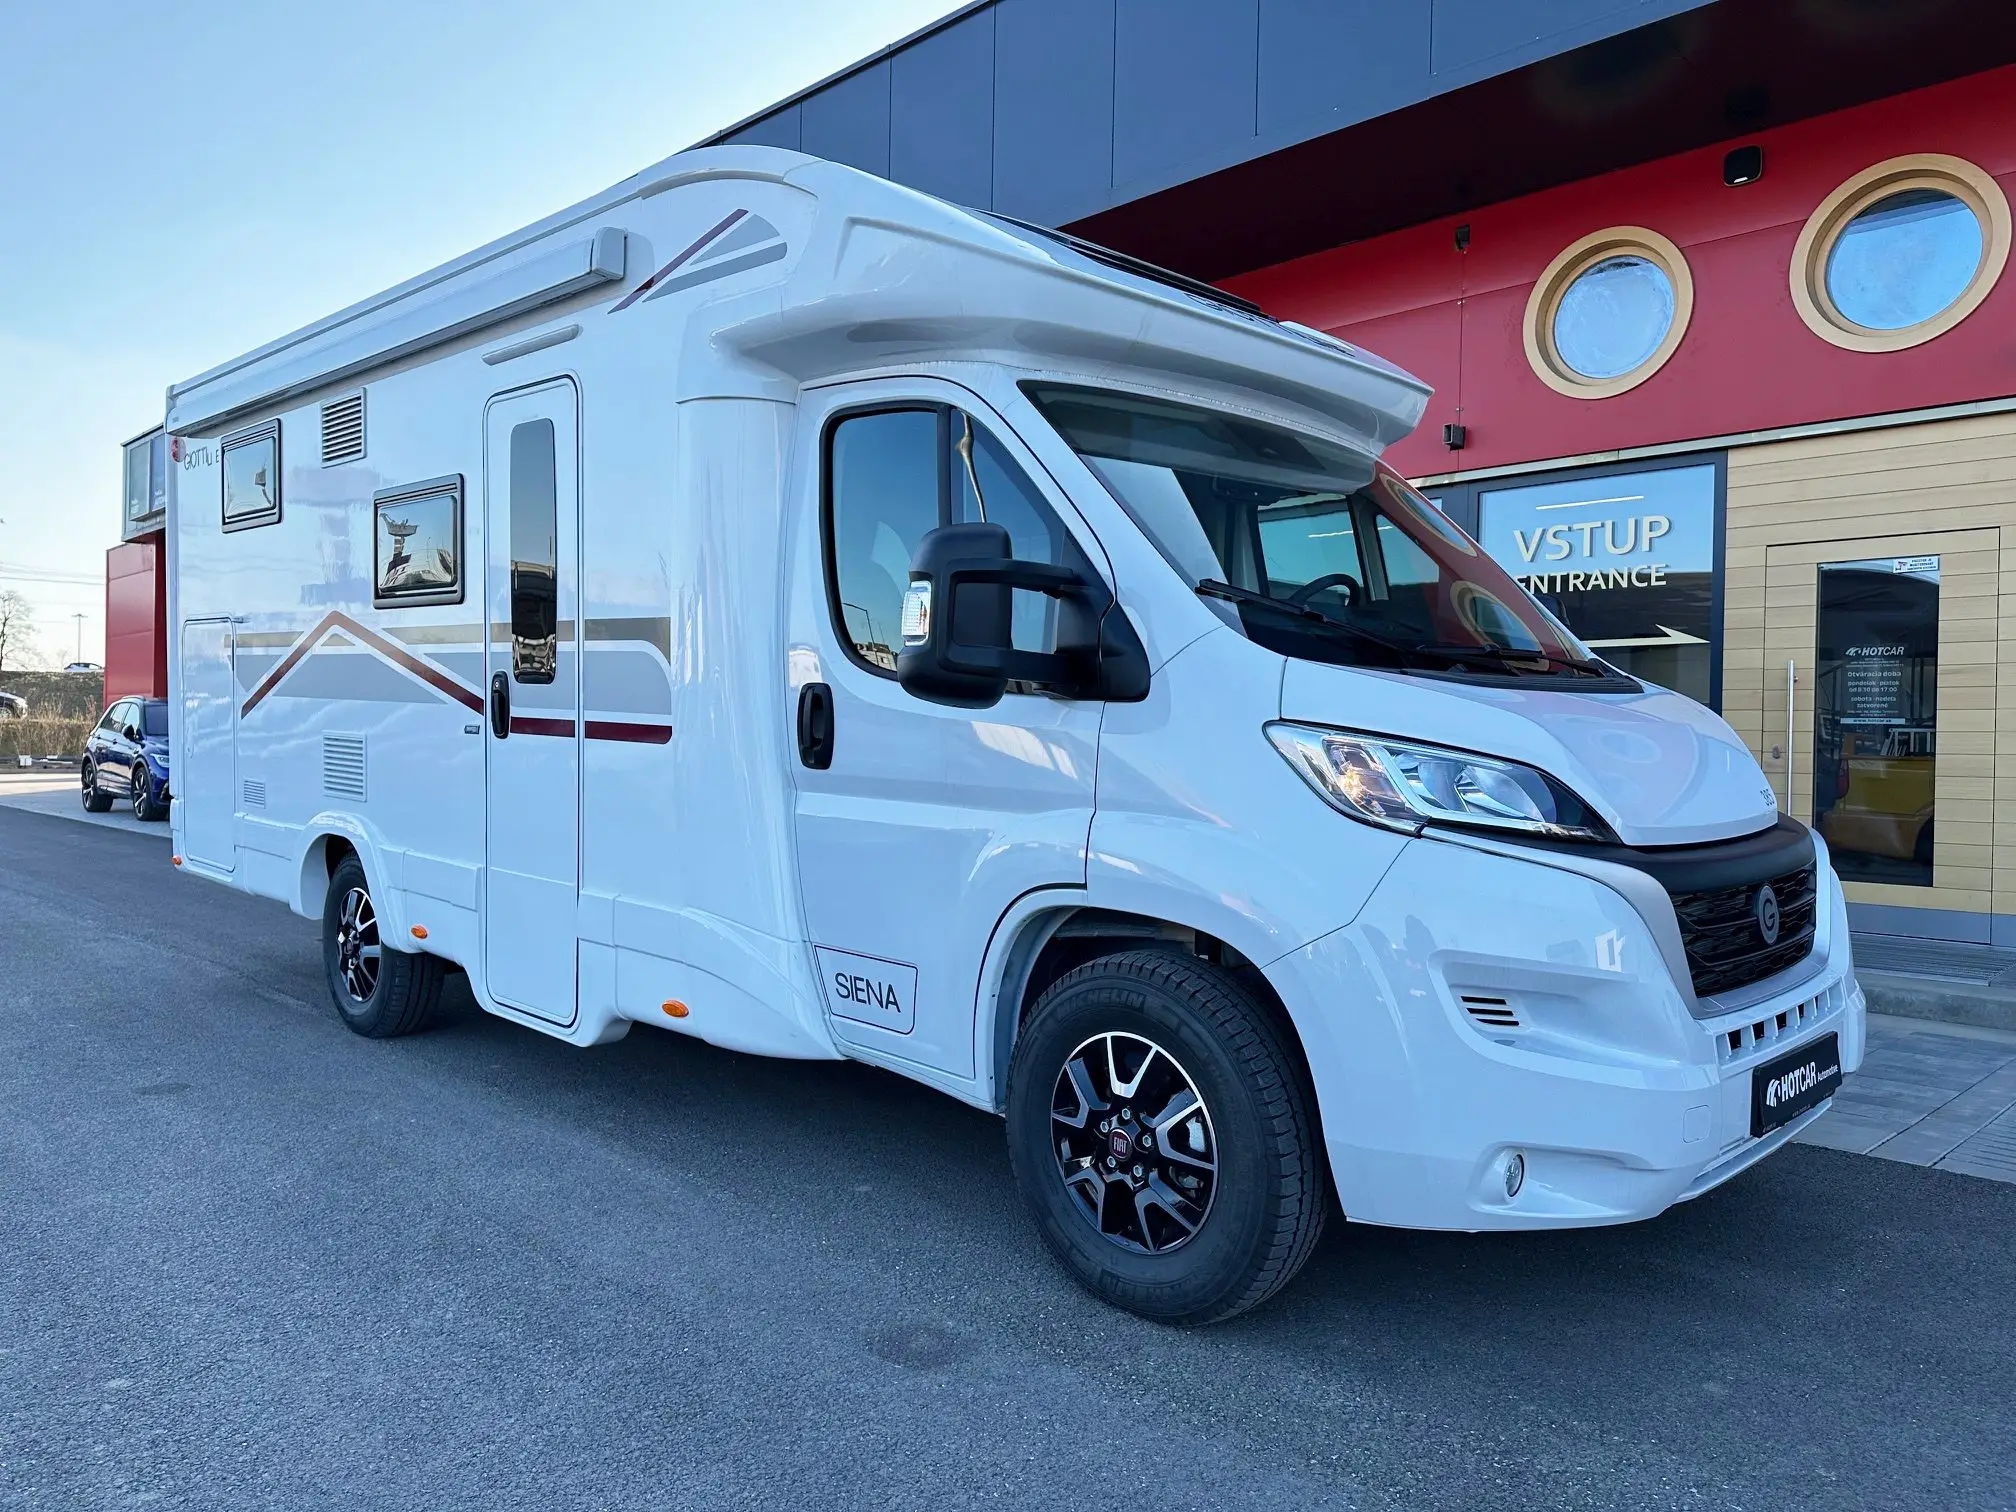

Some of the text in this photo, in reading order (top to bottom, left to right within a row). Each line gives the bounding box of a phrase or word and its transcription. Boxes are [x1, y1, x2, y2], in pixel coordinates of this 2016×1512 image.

[1513, 515, 1671, 562] VSTUP
[1861, 646, 1905, 656] HOTCAR
[834, 972, 901, 1013] SIENA
[1781, 1061, 1818, 1102] HOTCAR
[1113, 1136, 1128, 1153] FIAT
